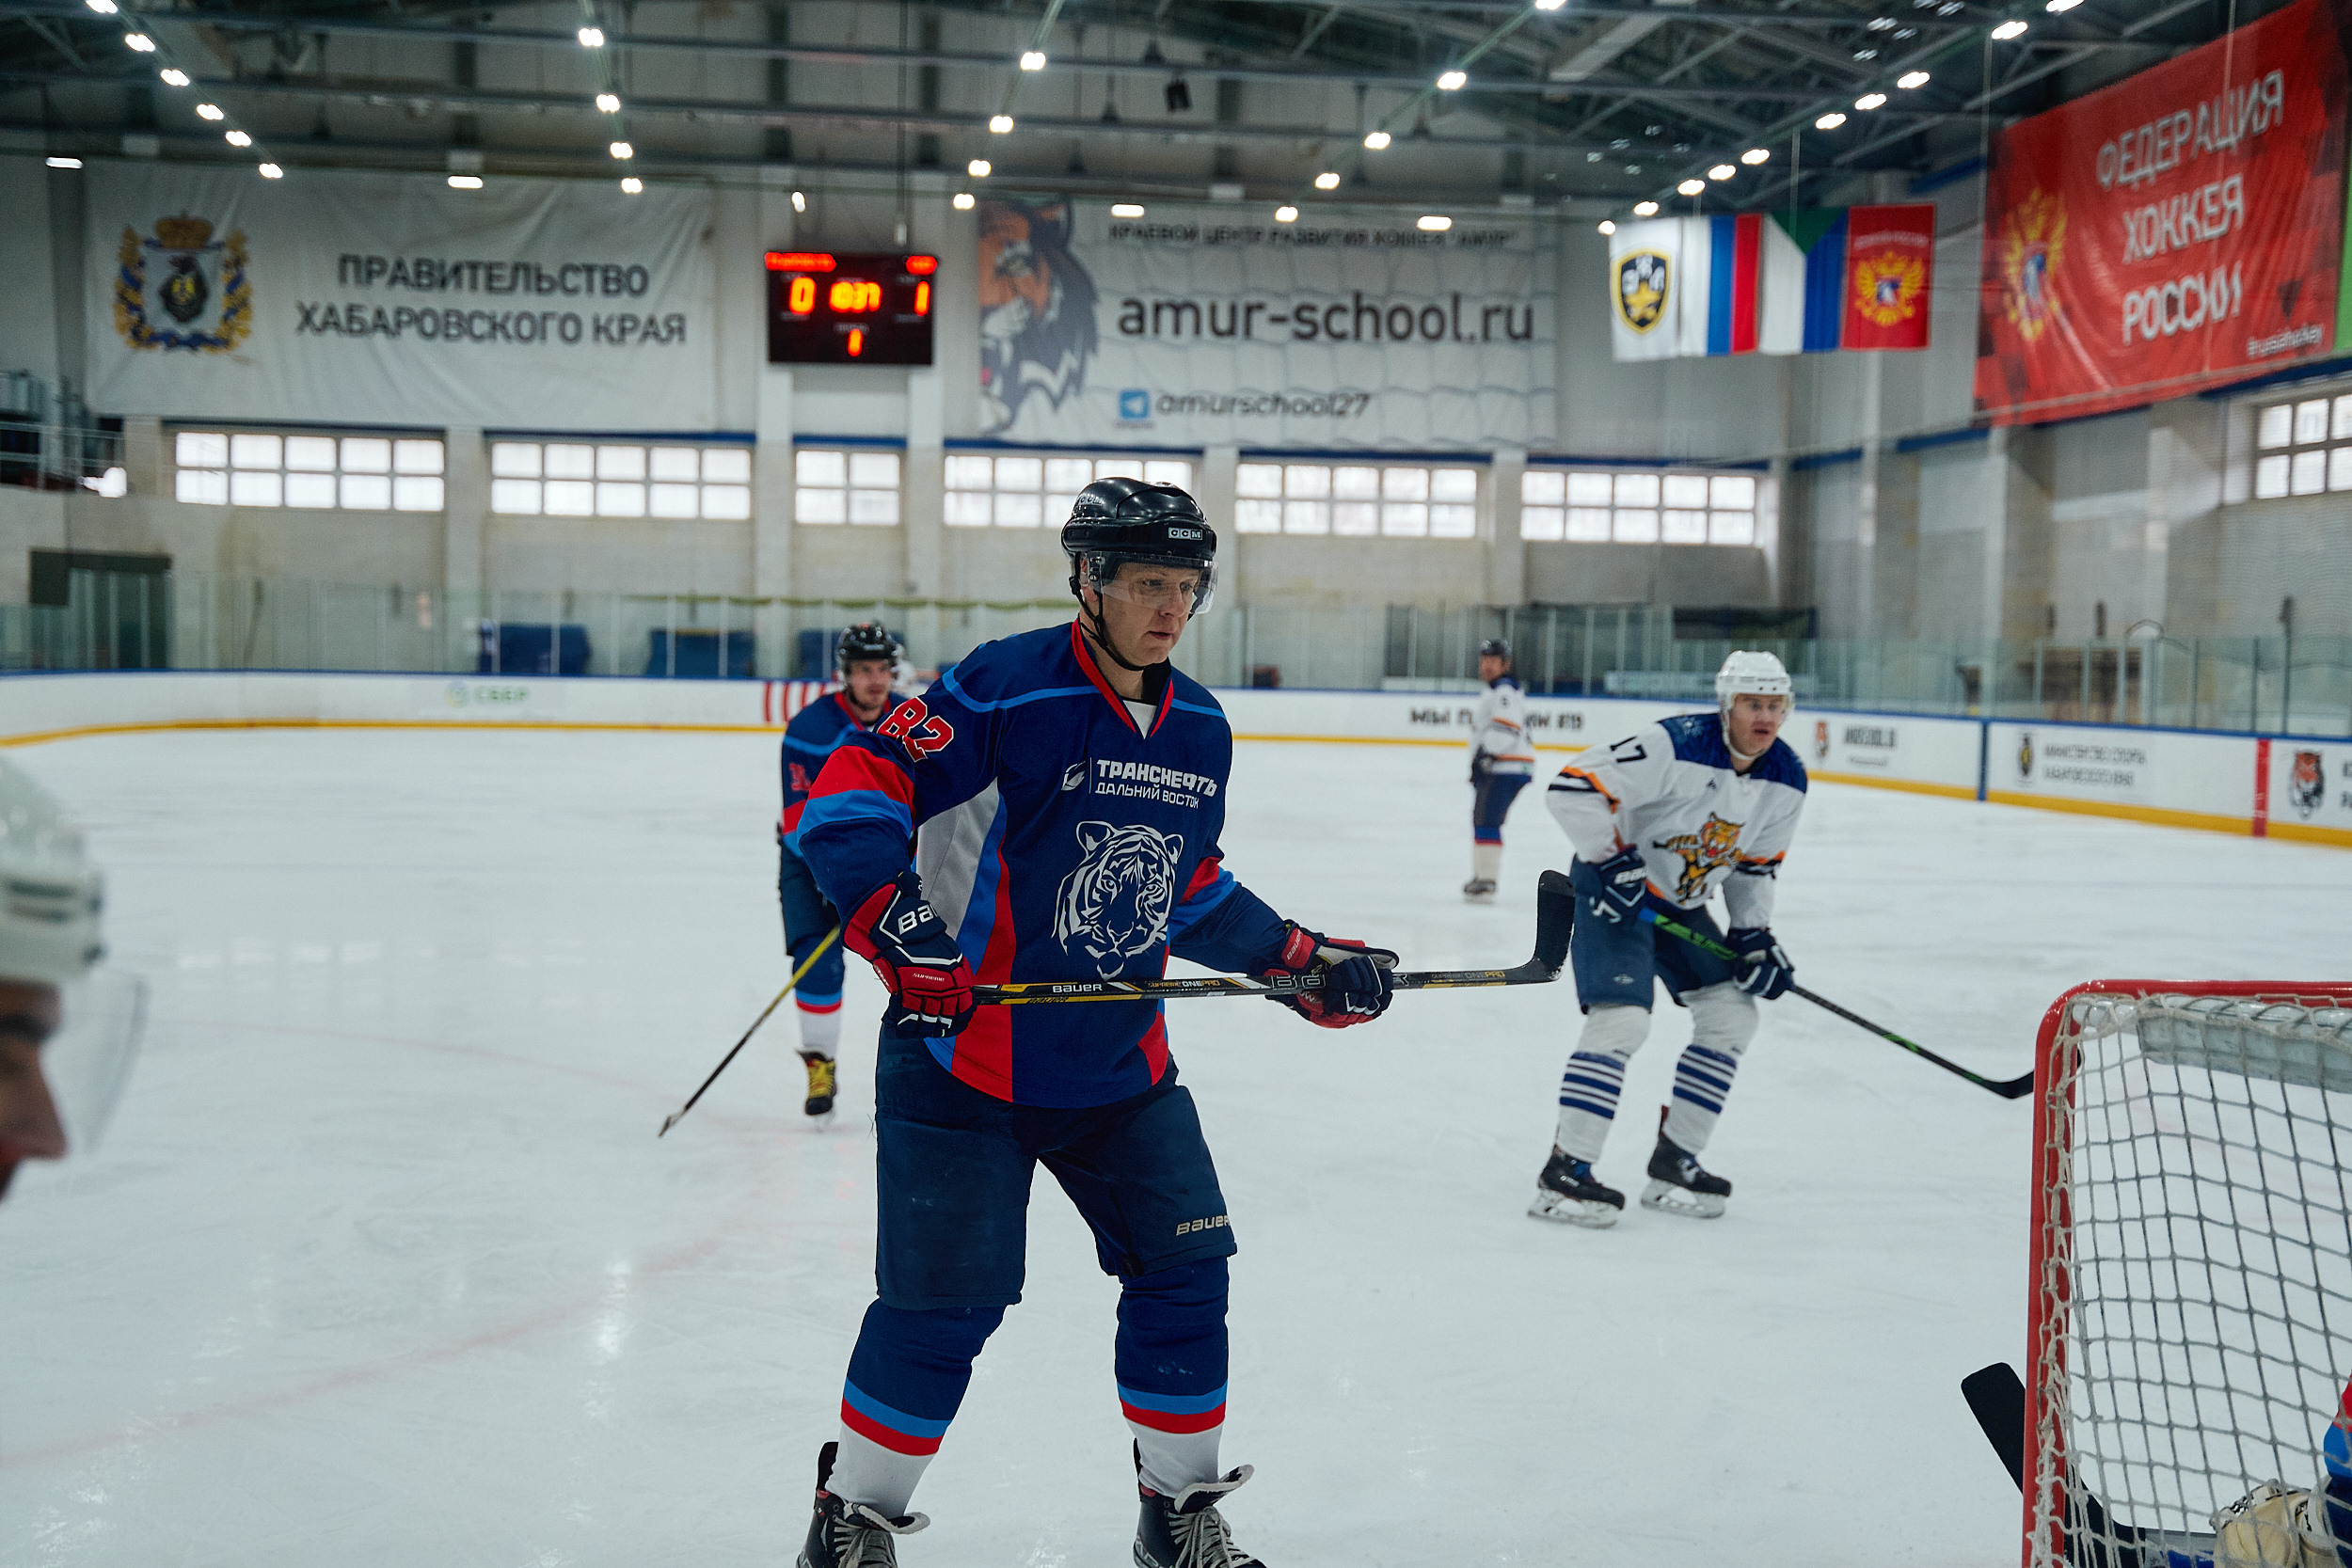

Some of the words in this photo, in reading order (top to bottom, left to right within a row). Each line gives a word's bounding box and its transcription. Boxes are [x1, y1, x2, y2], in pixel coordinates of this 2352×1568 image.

[2096, 69, 2284, 190] ФЕДЕРАЦИЯ
[2122, 173, 2245, 265] ХОККЕЯ
[338, 254, 649, 298] ПРАВИТЕЛЬСТВО
[789, 277, 816, 315] 0
[914, 281, 930, 316] 1
[1119, 290, 1534, 342] amur-school.ru
[2122, 260, 2242, 346] РОССИИ
[295, 299, 583, 345] ХАБАРОВСКОГО
[593, 312, 687, 347] КРАЯ
[848, 328, 864, 357] 1
[1169, 529, 1202, 540] CCM
[877, 696, 955, 763] 82
[1610, 736, 1647, 764] 17
[1095, 782, 1160, 800] ДАЛЬНИЙ
[1162, 790, 1200, 809] ВОСТОК
[1096, 759, 1217, 797] ТРАНСНЕФТЬ
